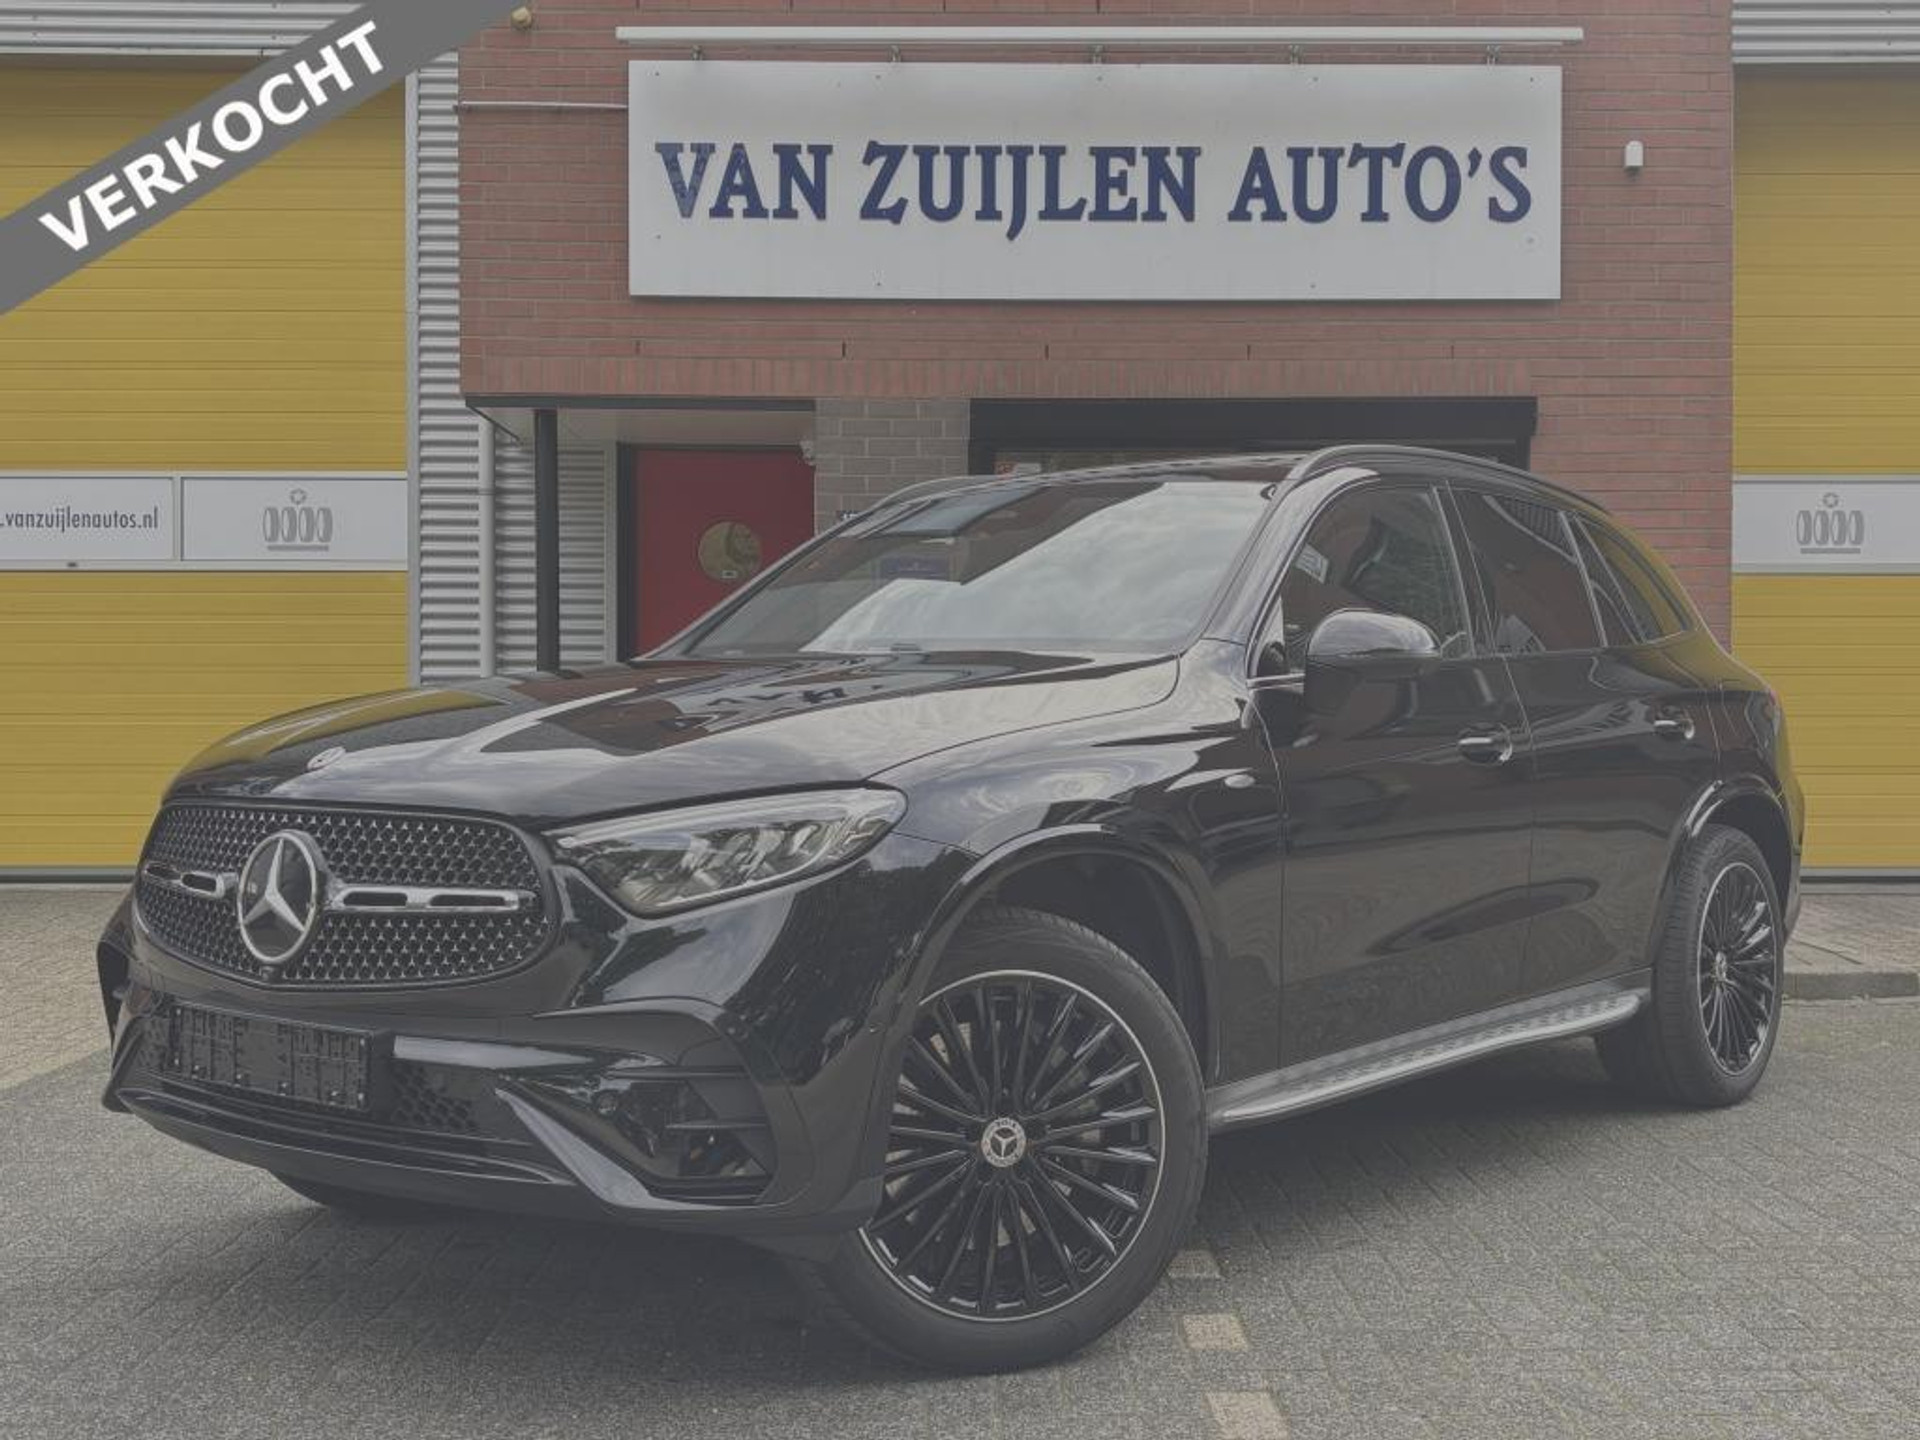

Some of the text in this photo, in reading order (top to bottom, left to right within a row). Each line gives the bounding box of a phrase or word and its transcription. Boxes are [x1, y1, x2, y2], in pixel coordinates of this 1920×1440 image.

[655, 141, 1533, 241] VAN ZUIJLEN AUTO'S
